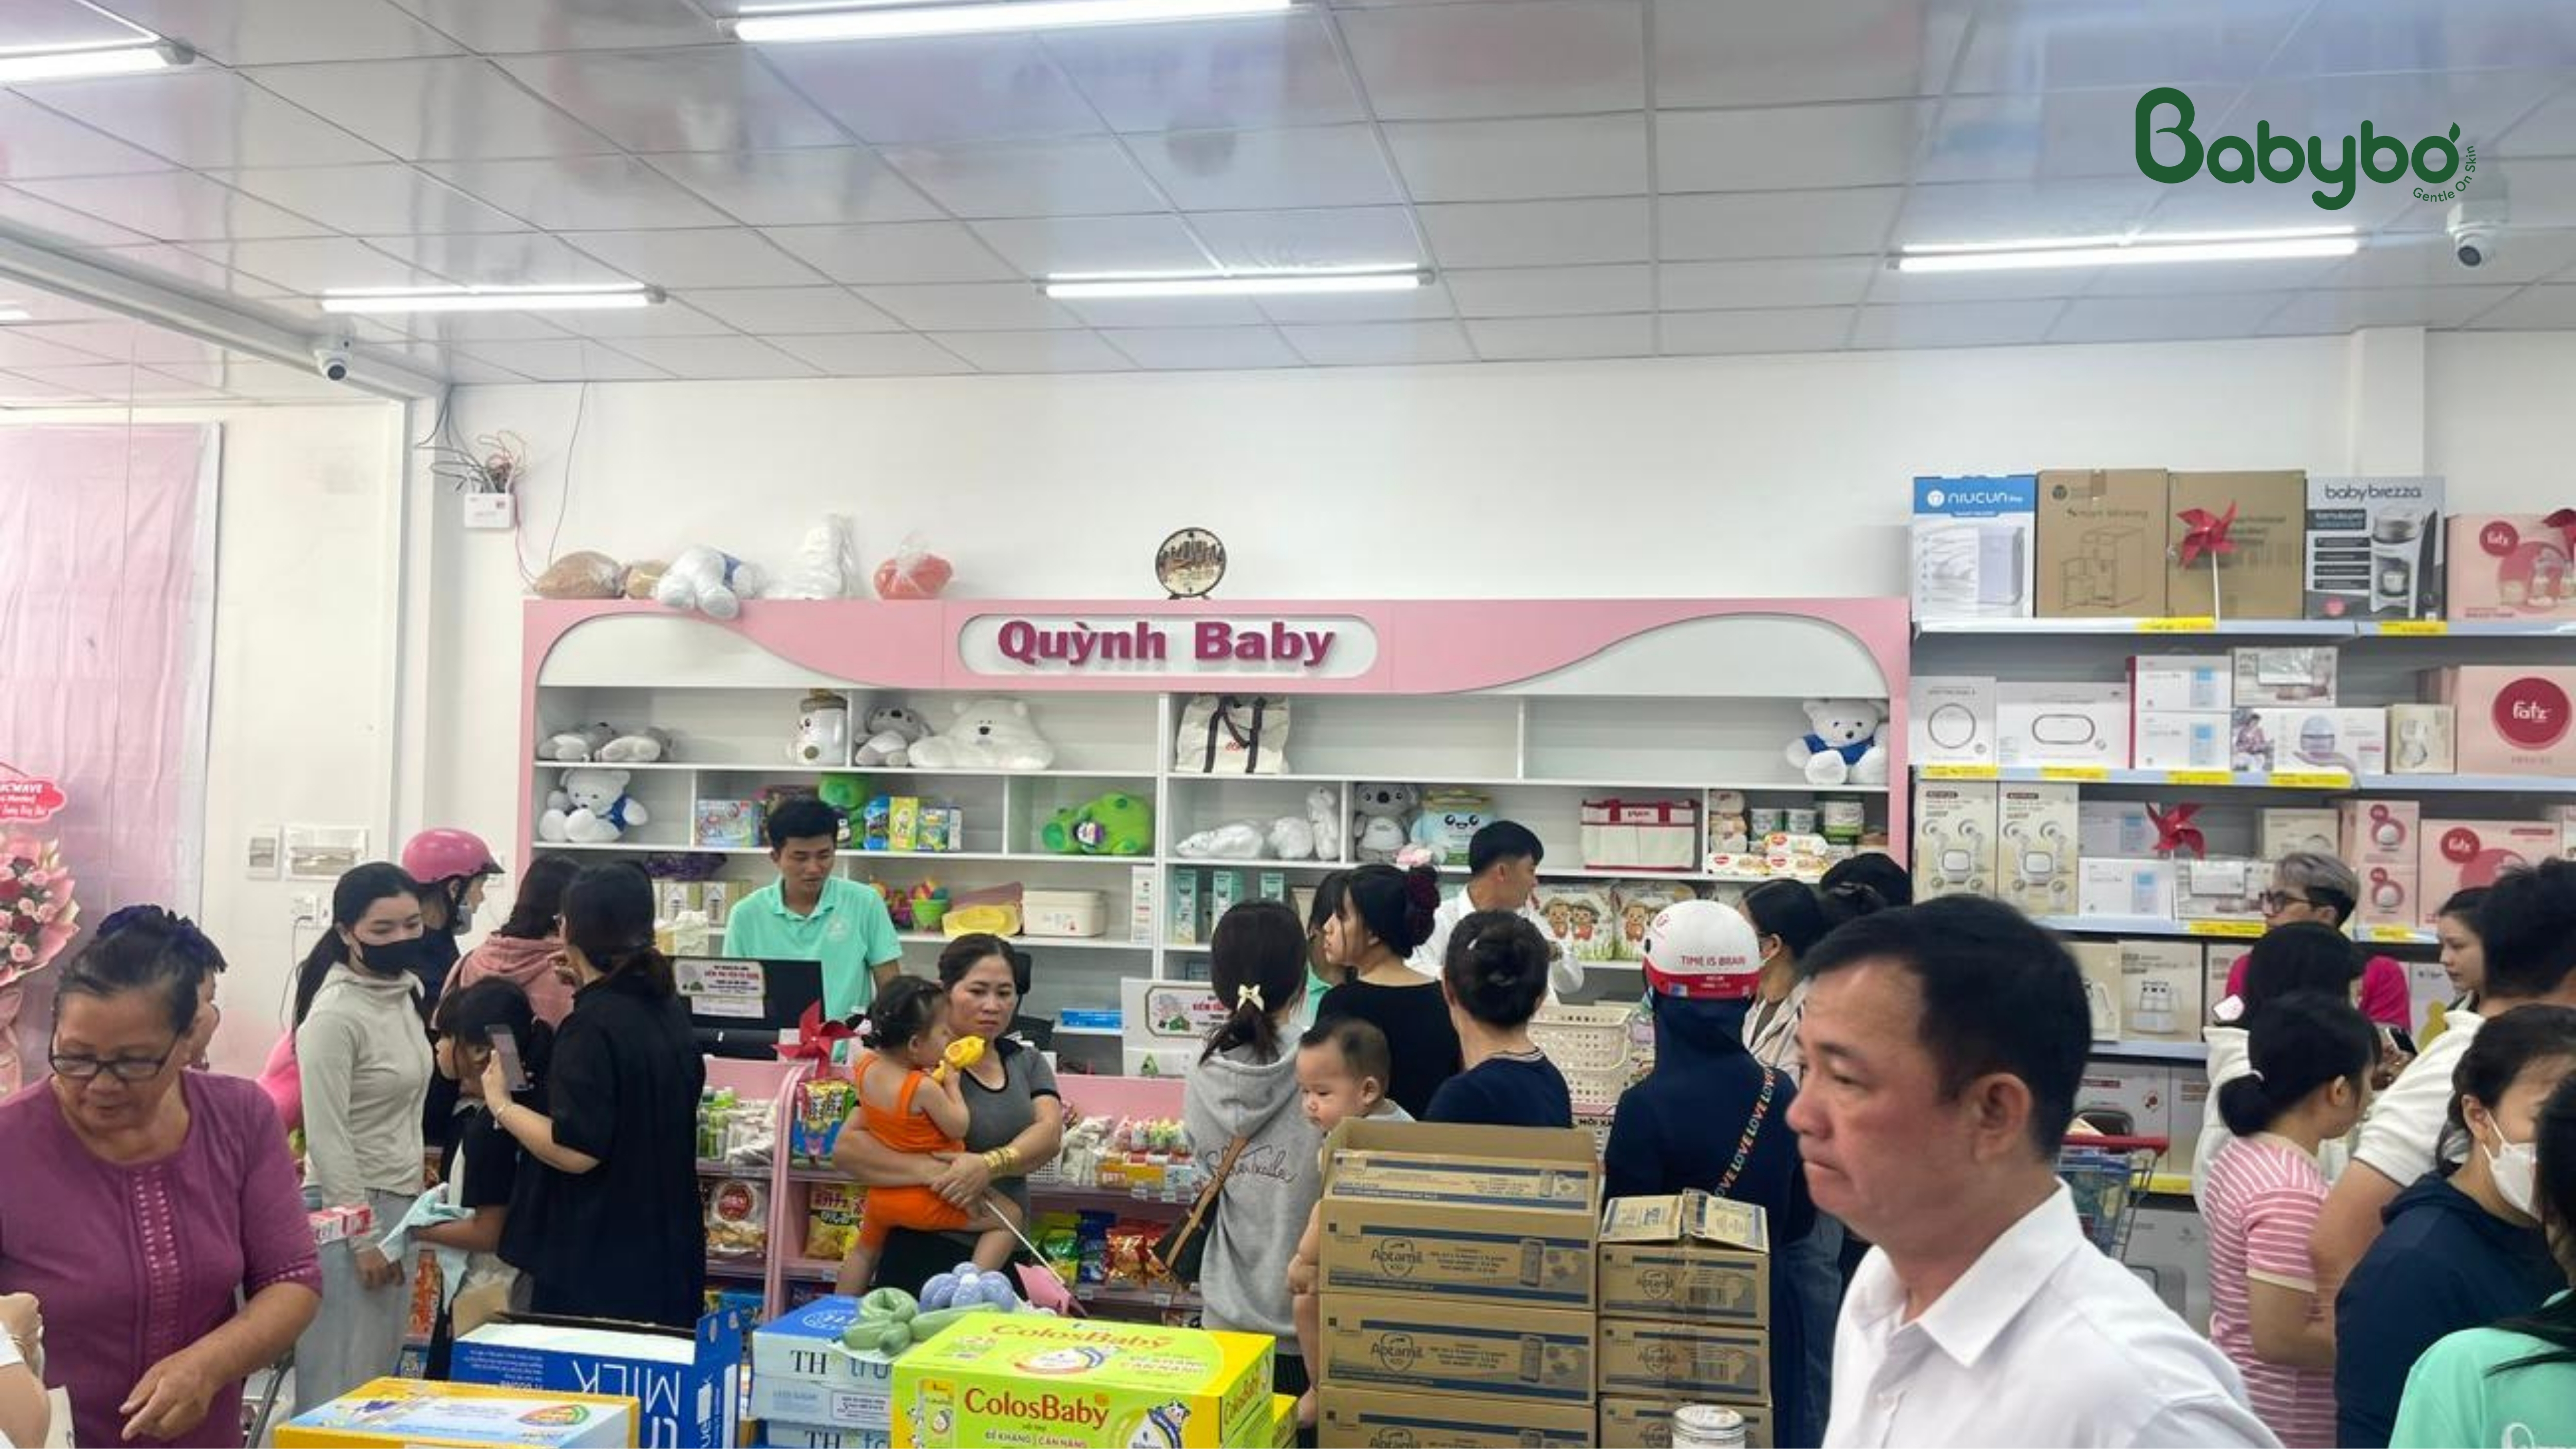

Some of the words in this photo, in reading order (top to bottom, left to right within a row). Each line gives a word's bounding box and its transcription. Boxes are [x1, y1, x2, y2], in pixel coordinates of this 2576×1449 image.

[998, 621, 1166, 666] Quỳnh
[1194, 622, 1336, 667] Baby
[1681, 956, 1703, 966] TIME
[1706, 957, 1717, 966] IS
[1714, 1169, 1738, 1198] OVE
[790, 1349, 827, 1375] TH
[850, 1358, 889, 1379] tru
[964, 1387, 1110, 1431] ColosBaby
